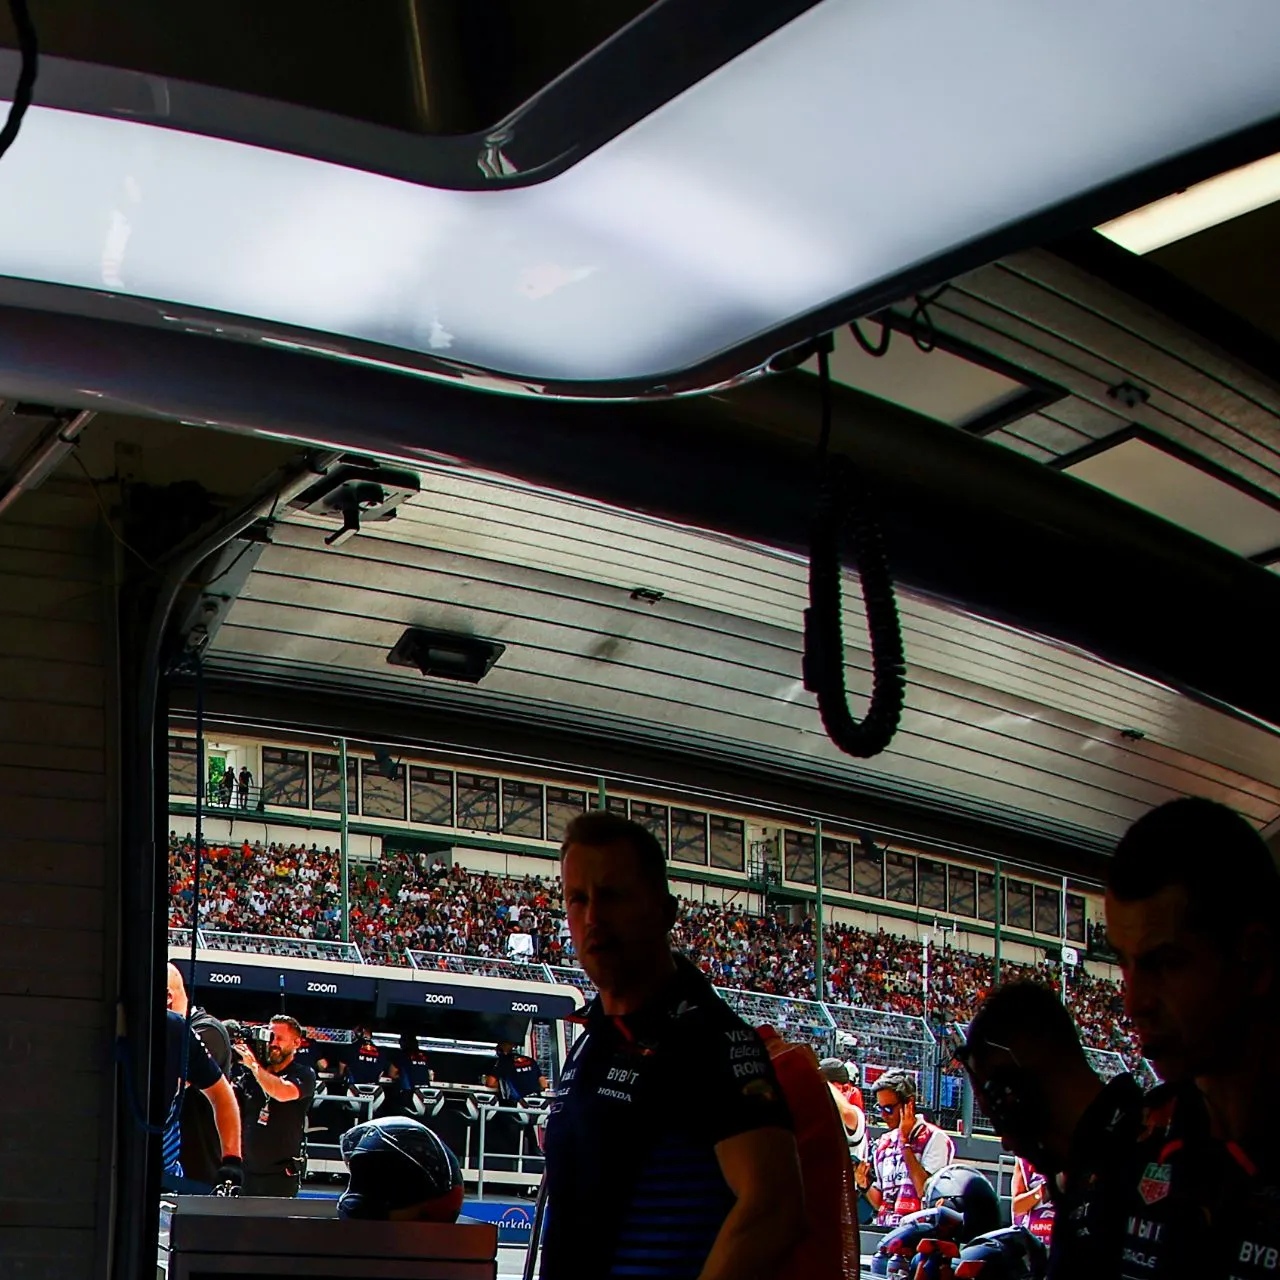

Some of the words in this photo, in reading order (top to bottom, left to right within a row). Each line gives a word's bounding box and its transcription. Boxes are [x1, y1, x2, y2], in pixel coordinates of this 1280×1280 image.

[209, 972, 241, 985] zoom
[307, 982, 337, 994] zoom
[425, 993, 453, 1005] zoom
[511, 1002, 538, 1013] zoom
[606, 1066, 640, 1085] BYBIT
[596, 1085, 633, 1102] HONDA
[1145, 1165, 1172, 1180] TAG
[1238, 1240, 1280, 1270] BYB
